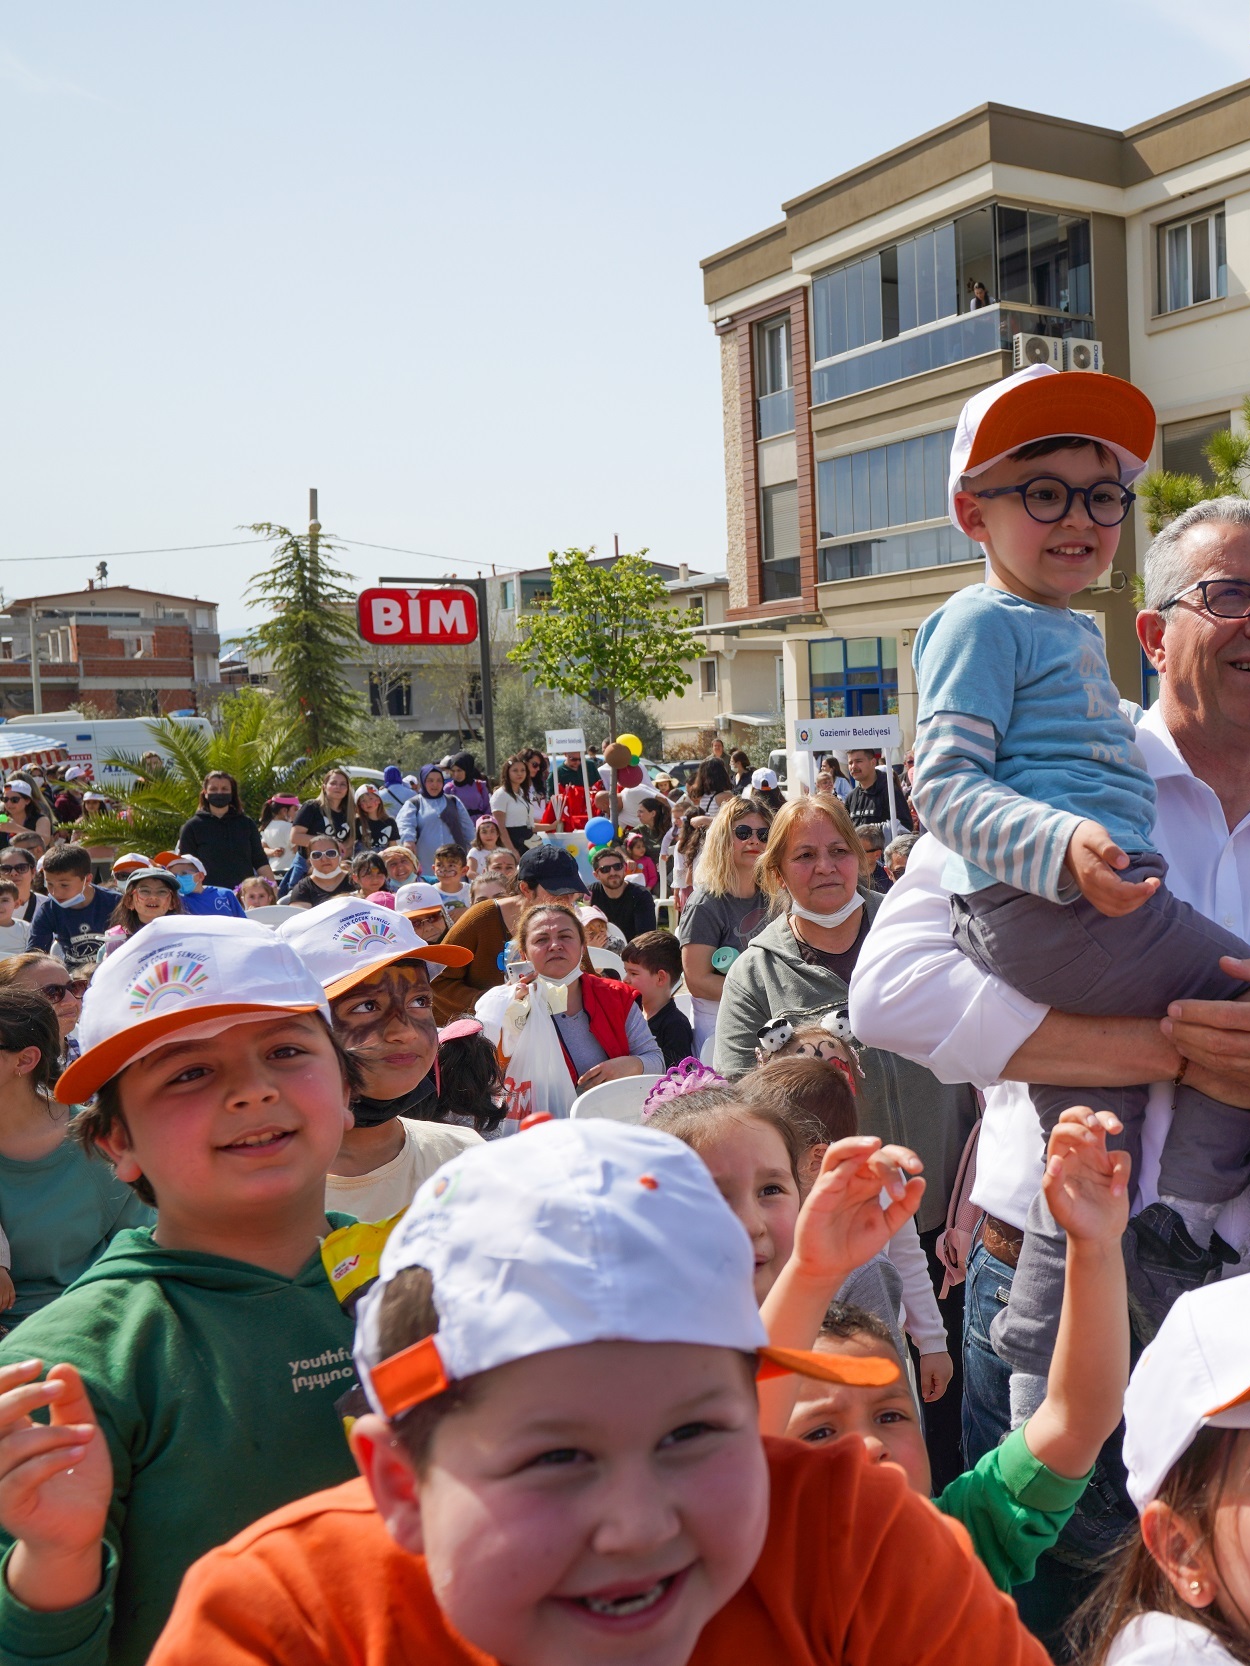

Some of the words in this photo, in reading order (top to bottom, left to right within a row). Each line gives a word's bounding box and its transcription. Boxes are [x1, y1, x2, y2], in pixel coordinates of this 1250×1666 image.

[371, 589, 469, 635] BİM
[819, 728, 850, 737] Gaziemir
[852, 726, 891, 738] Belediyesi
[287, 1346, 354, 1376] youthfu
[291, 1366, 354, 1394] outhful
